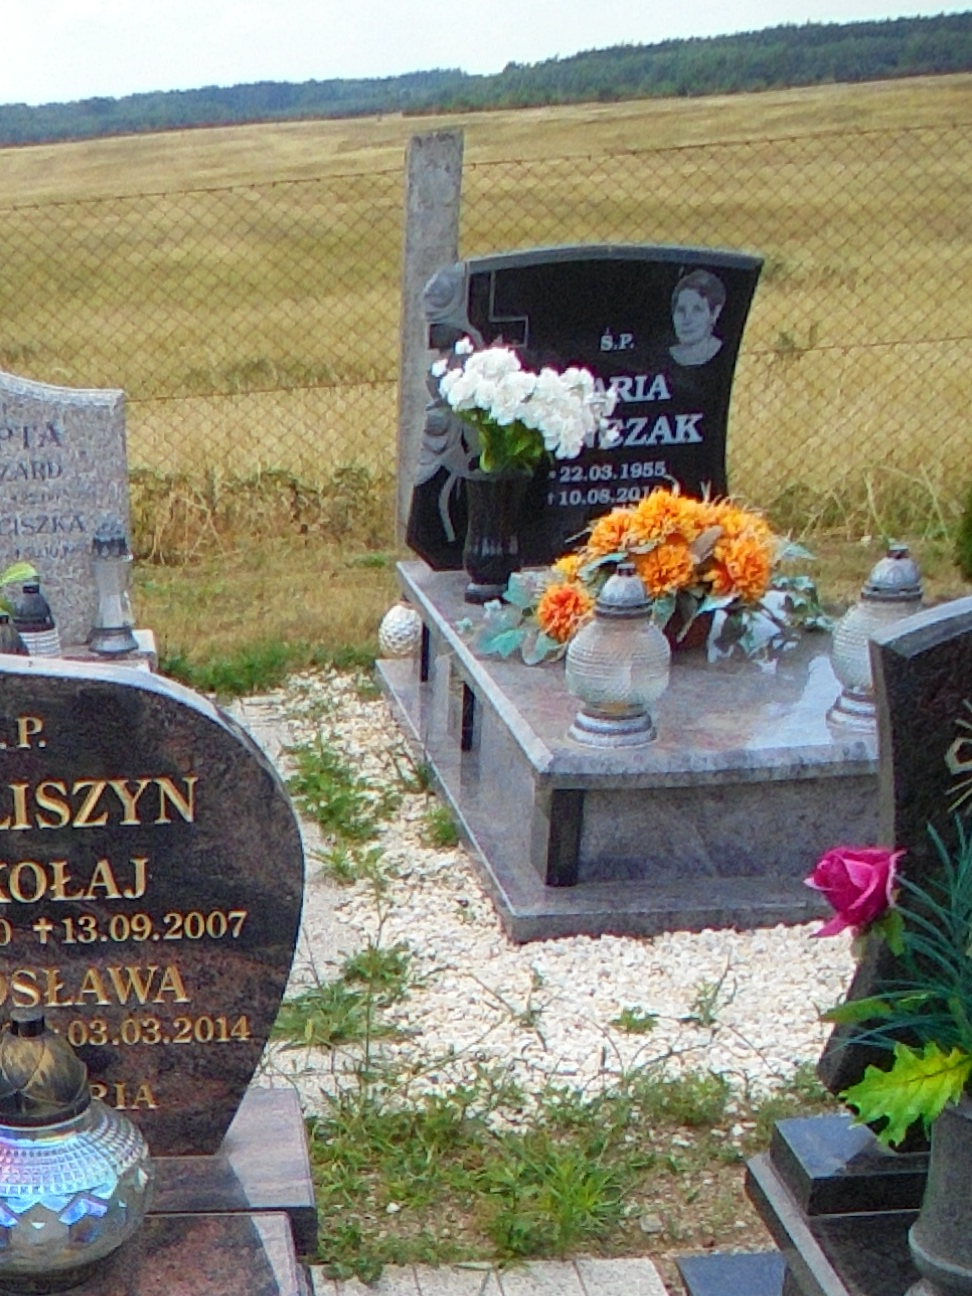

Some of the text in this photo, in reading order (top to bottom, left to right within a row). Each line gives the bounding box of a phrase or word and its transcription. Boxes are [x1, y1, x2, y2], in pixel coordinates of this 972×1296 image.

[594, 374, 671, 402] ARIA
[559, 485, 664, 507] 10.08.201
[62, 910, 247, 944] 13.09.2007
[68, 1015, 251, 1047] 03.03.2014
[90, 1082, 160, 1110] RIA
